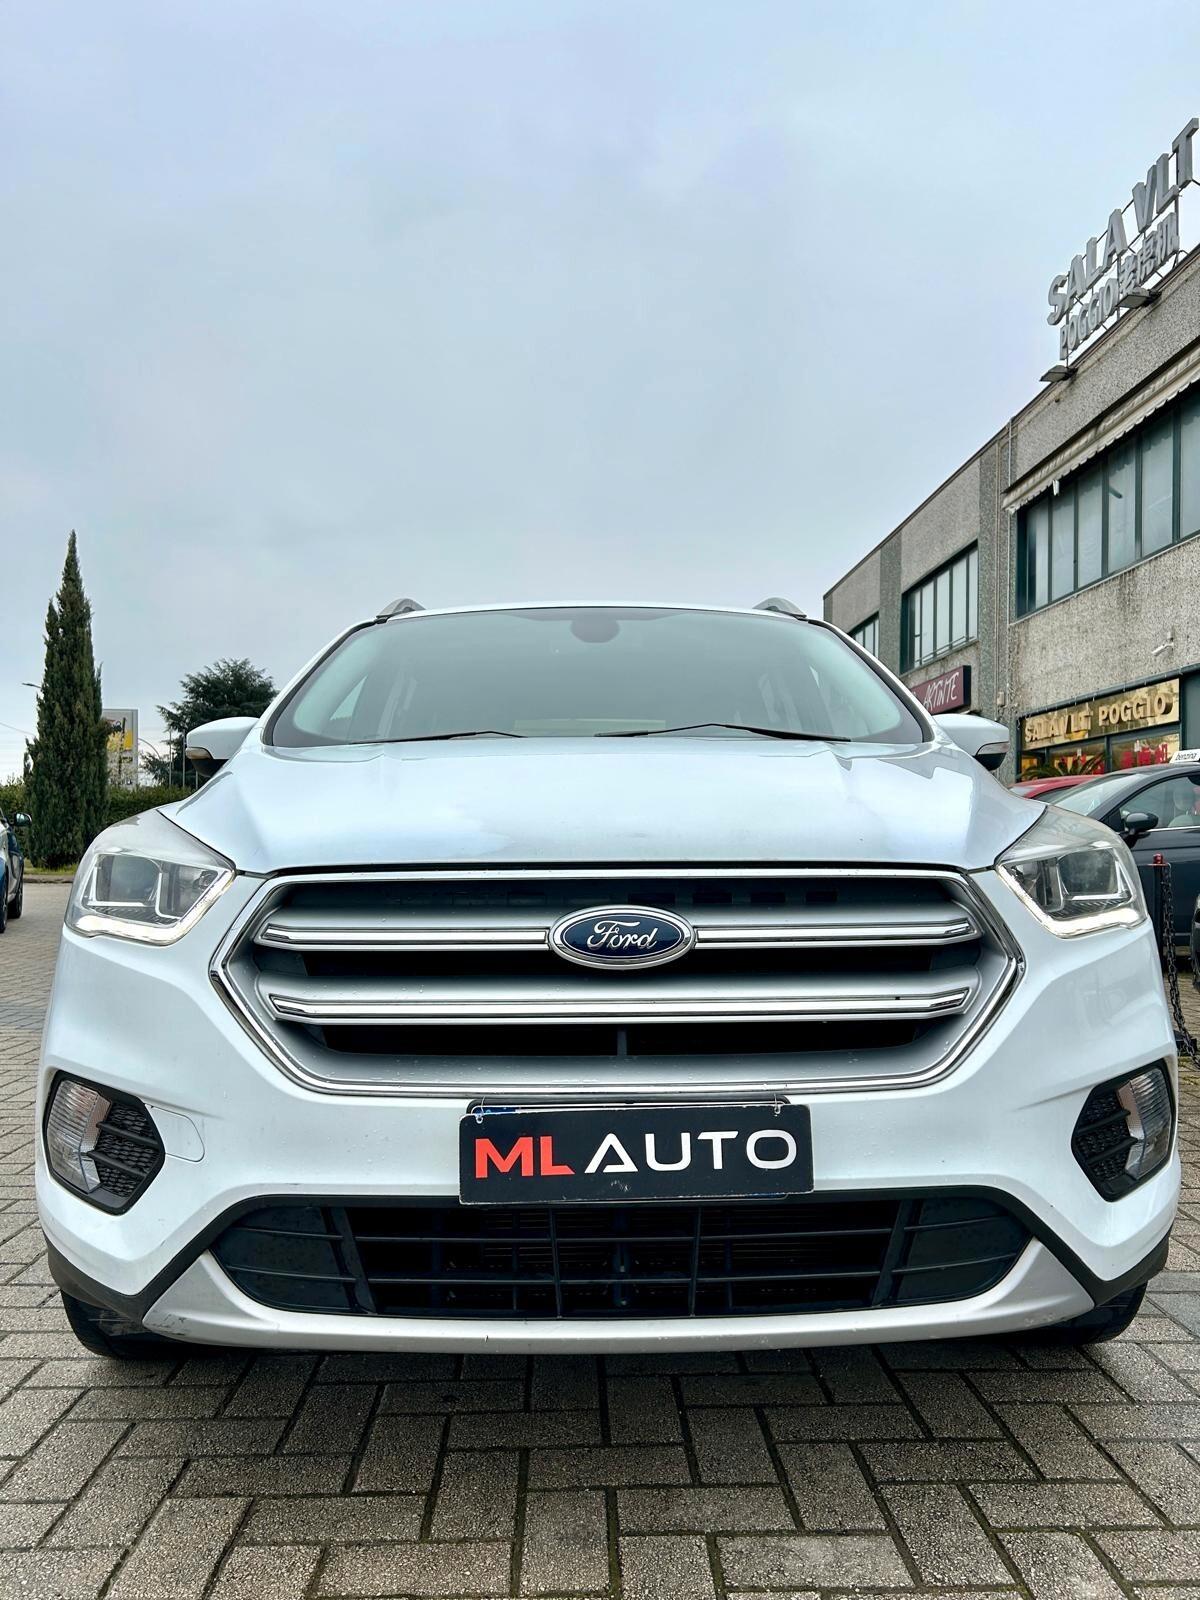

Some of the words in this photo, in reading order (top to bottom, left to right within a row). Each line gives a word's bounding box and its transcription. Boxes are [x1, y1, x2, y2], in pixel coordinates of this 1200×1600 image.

[1047, 209, 1127, 325] SALA
[1132, 118, 1199, 233] VLT
[1119, 212, 1179, 294] 老虎机
[1060, 278, 1119, 360] POGGIO
[1099, 694, 1168, 726] POGGIO
[586, 919, 659, 951] Ford
[584, 1129, 797, 1174] AUTO
